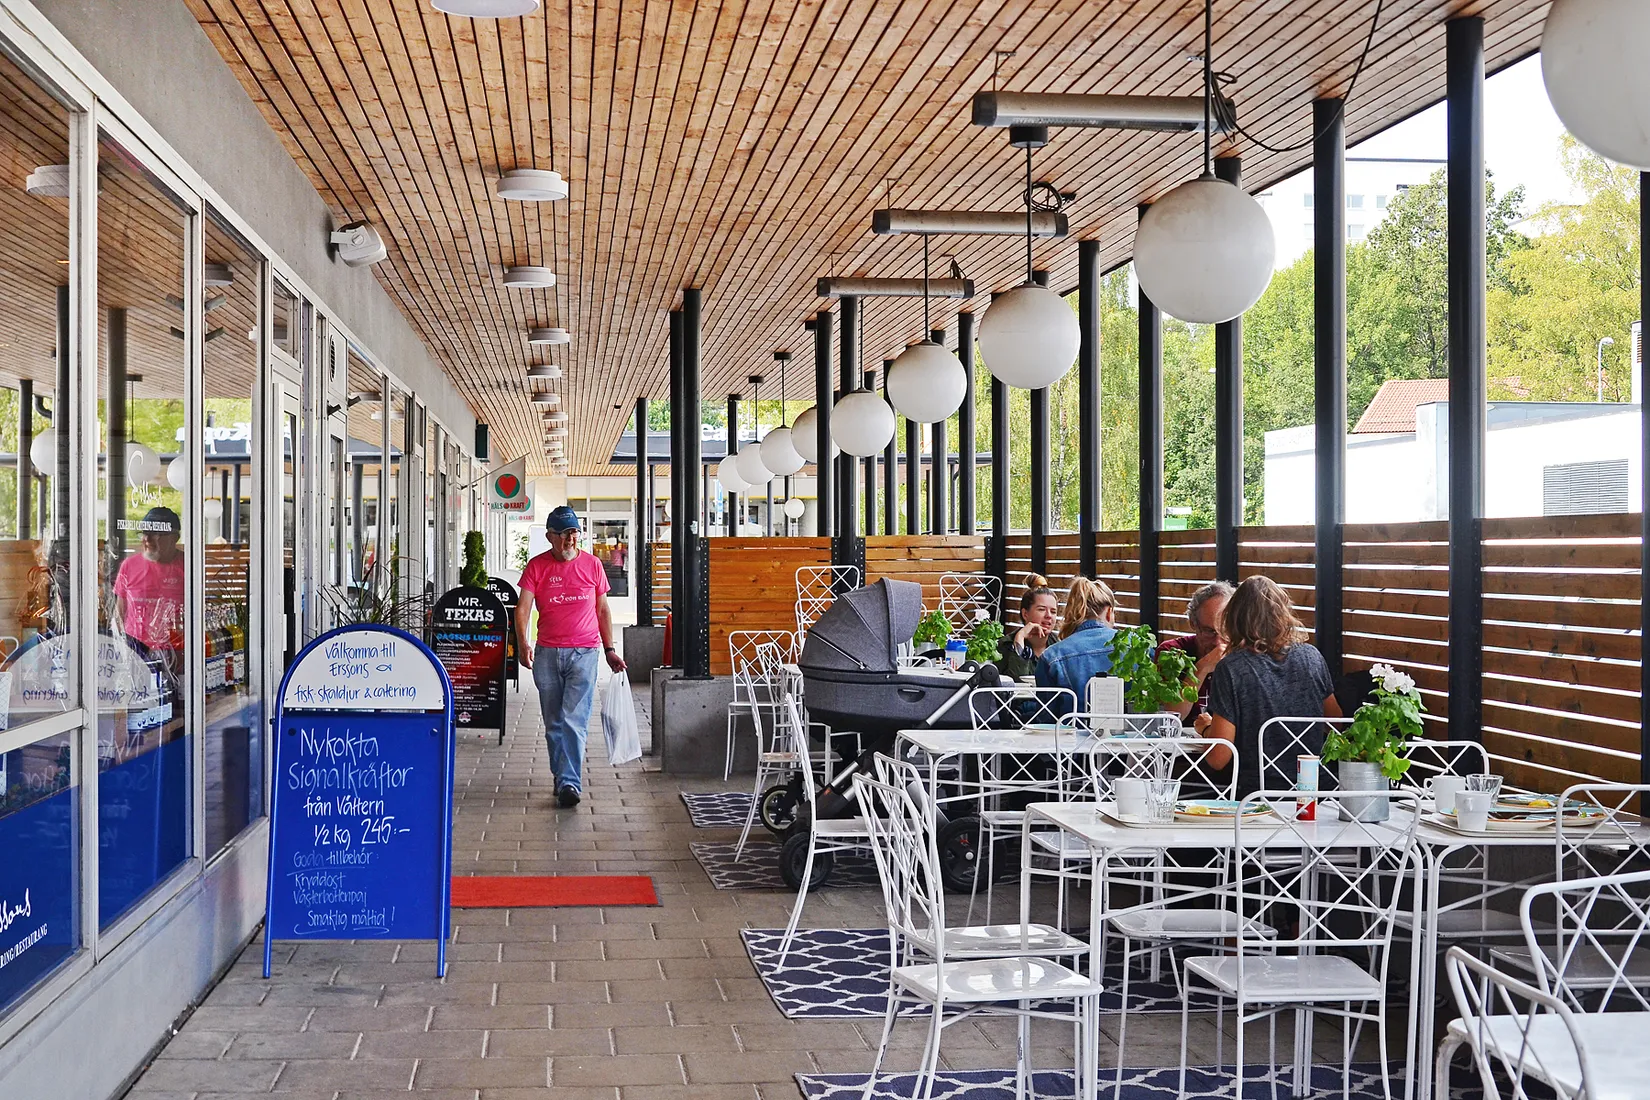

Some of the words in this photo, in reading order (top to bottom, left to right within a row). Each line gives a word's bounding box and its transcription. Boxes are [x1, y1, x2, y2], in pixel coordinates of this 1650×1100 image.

[458, 597, 483, 607] MR.
[444, 608, 495, 622] TEXAS
[436, 633, 471, 641] DAGENS
[473, 634, 502, 642] LUNCH
[325, 642, 378, 663] Välkomna
[380, 642, 396, 658] till
[329, 662, 369, 678] Erssons
[318, 684, 360, 703] skaldjur
[364, 688, 372, 698] &
[373, 683, 416, 701] catering
[300, 728, 379, 765] Nykokta
[288, 761, 414, 799] Signalkräftor
[303, 796, 332, 818] från
[336, 795, 384, 816] Vättern
[334, 824, 351, 850] kg
[295, 872, 347, 890] Kryddost
[307, 909, 347, 931] Smaklig
